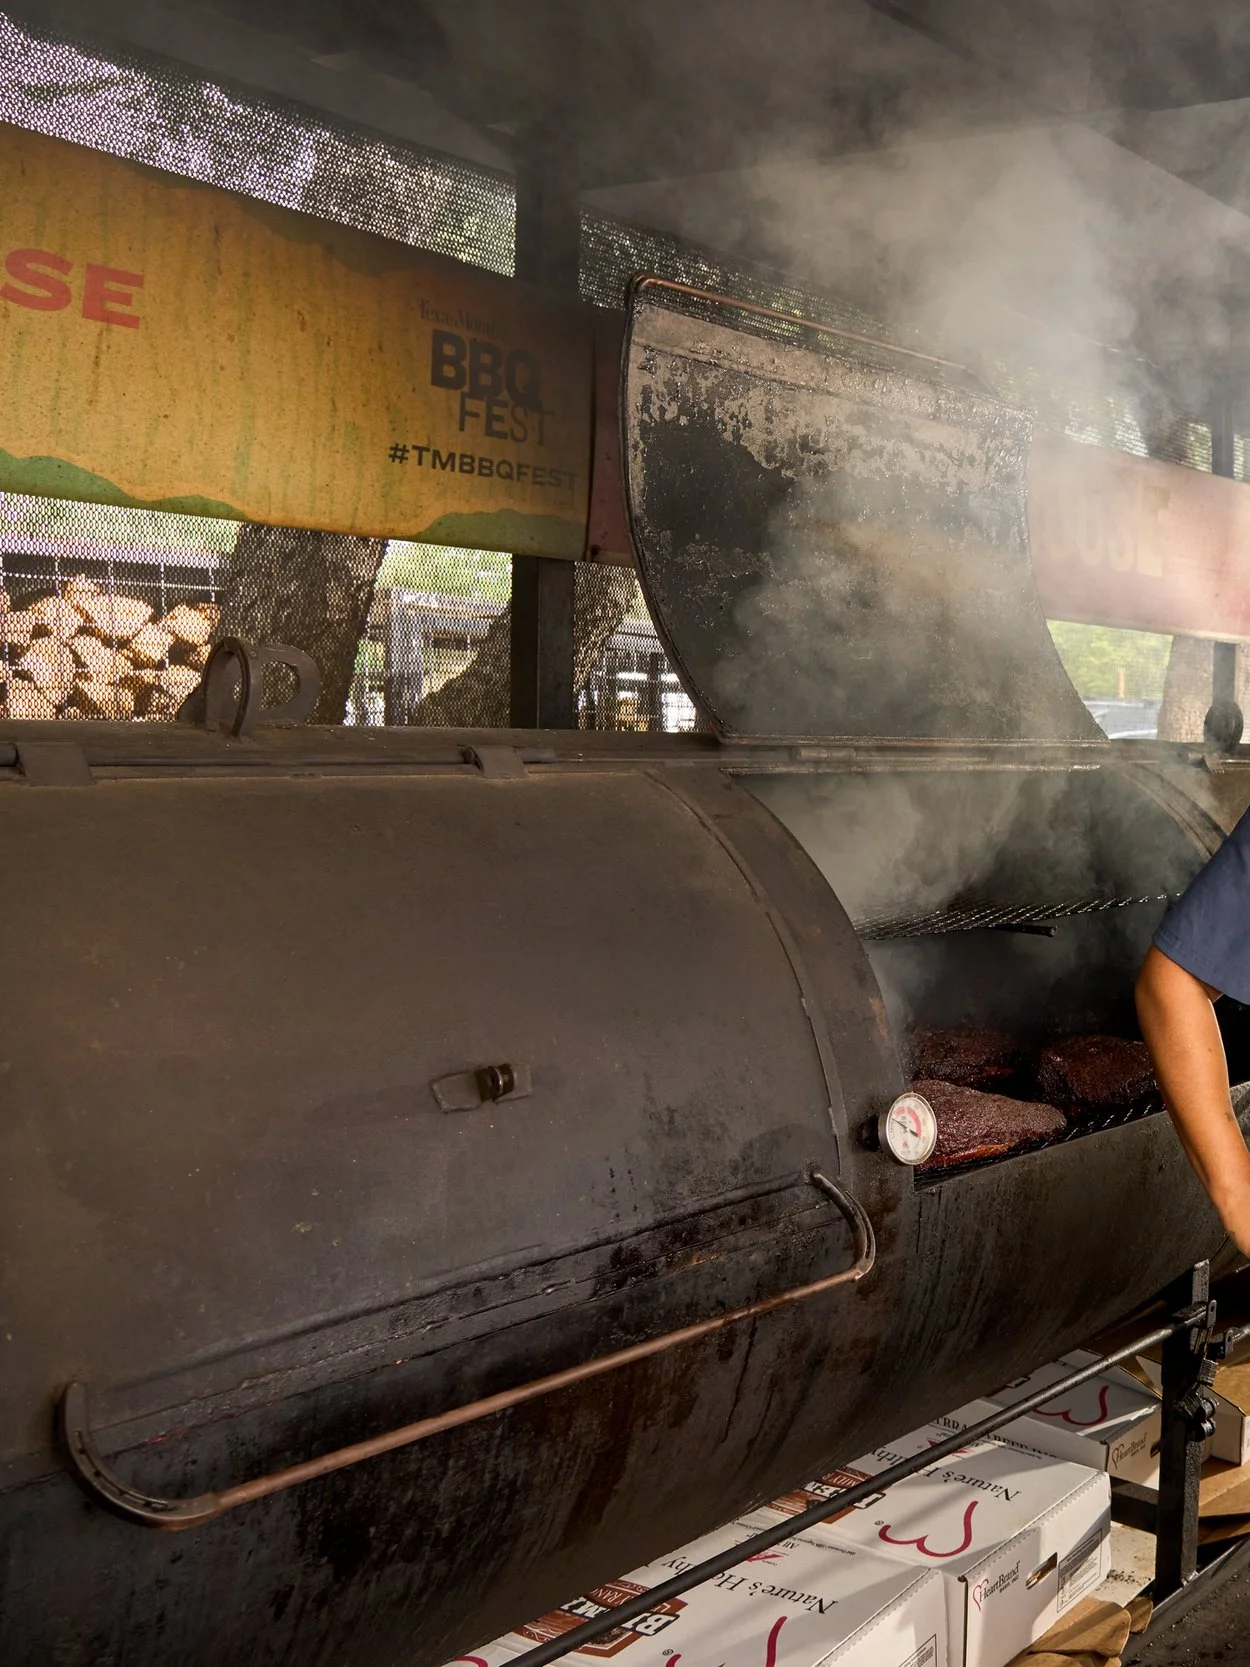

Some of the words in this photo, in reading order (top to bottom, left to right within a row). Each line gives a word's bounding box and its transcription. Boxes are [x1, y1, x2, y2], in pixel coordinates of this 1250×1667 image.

[431, 329, 543, 413] BBQ
[458, 391, 555, 446] FEST
[388, 443, 578, 490] #TMBBQFEST
[942, 1469, 1021, 1501] Nature's
[662, 1556, 748, 1592] Hehy
[749, 1581, 838, 1614] Nature's
